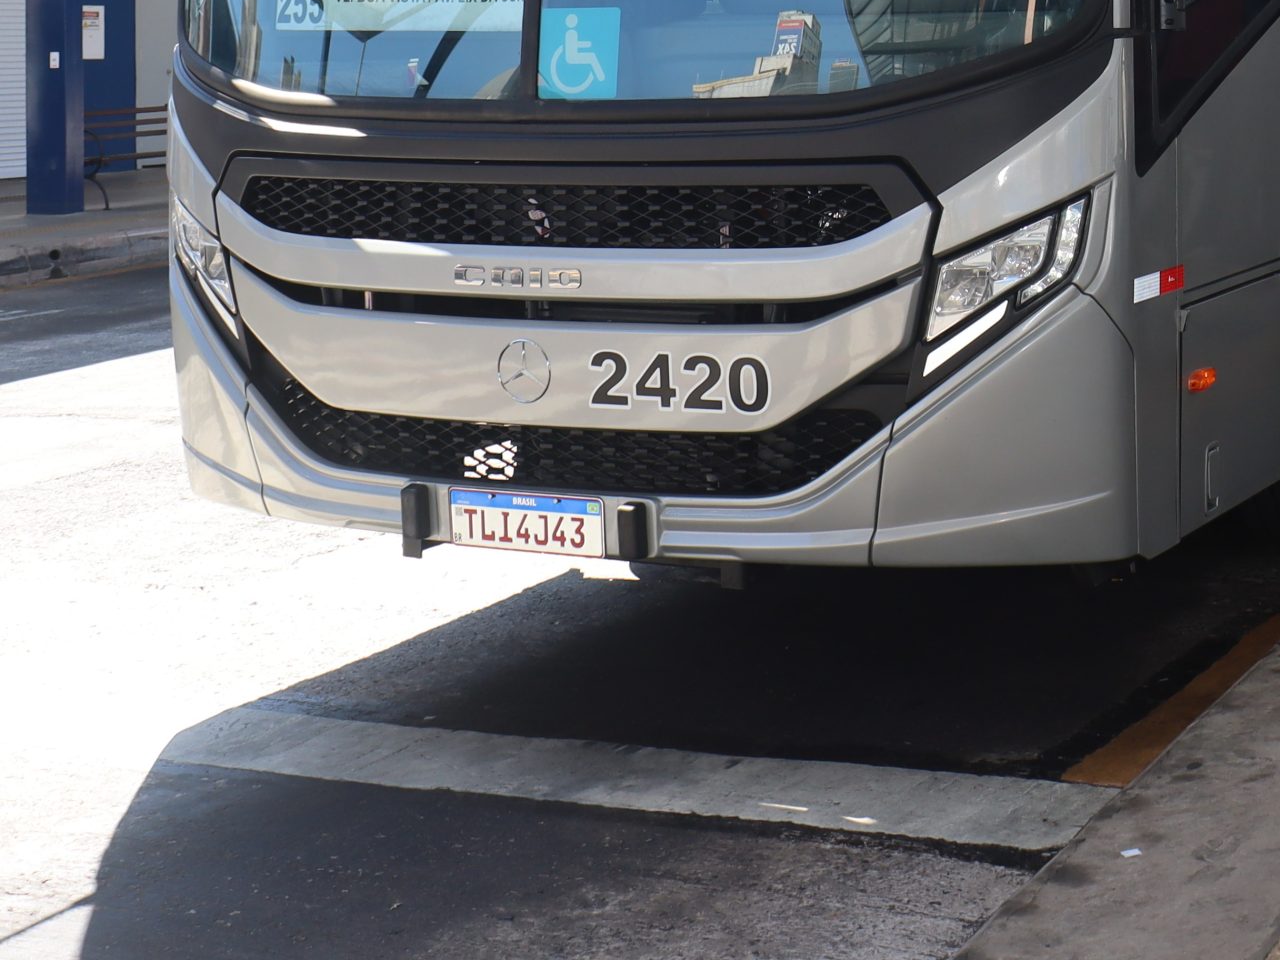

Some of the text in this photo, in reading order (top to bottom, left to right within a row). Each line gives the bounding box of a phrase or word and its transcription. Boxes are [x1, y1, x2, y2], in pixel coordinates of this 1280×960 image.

[453, 264, 583, 289] CAIO
[589, 350, 769, 413] 2420
[512, 497, 536, 507] BRASIL
[463, 508, 585, 549] TLI4J43
